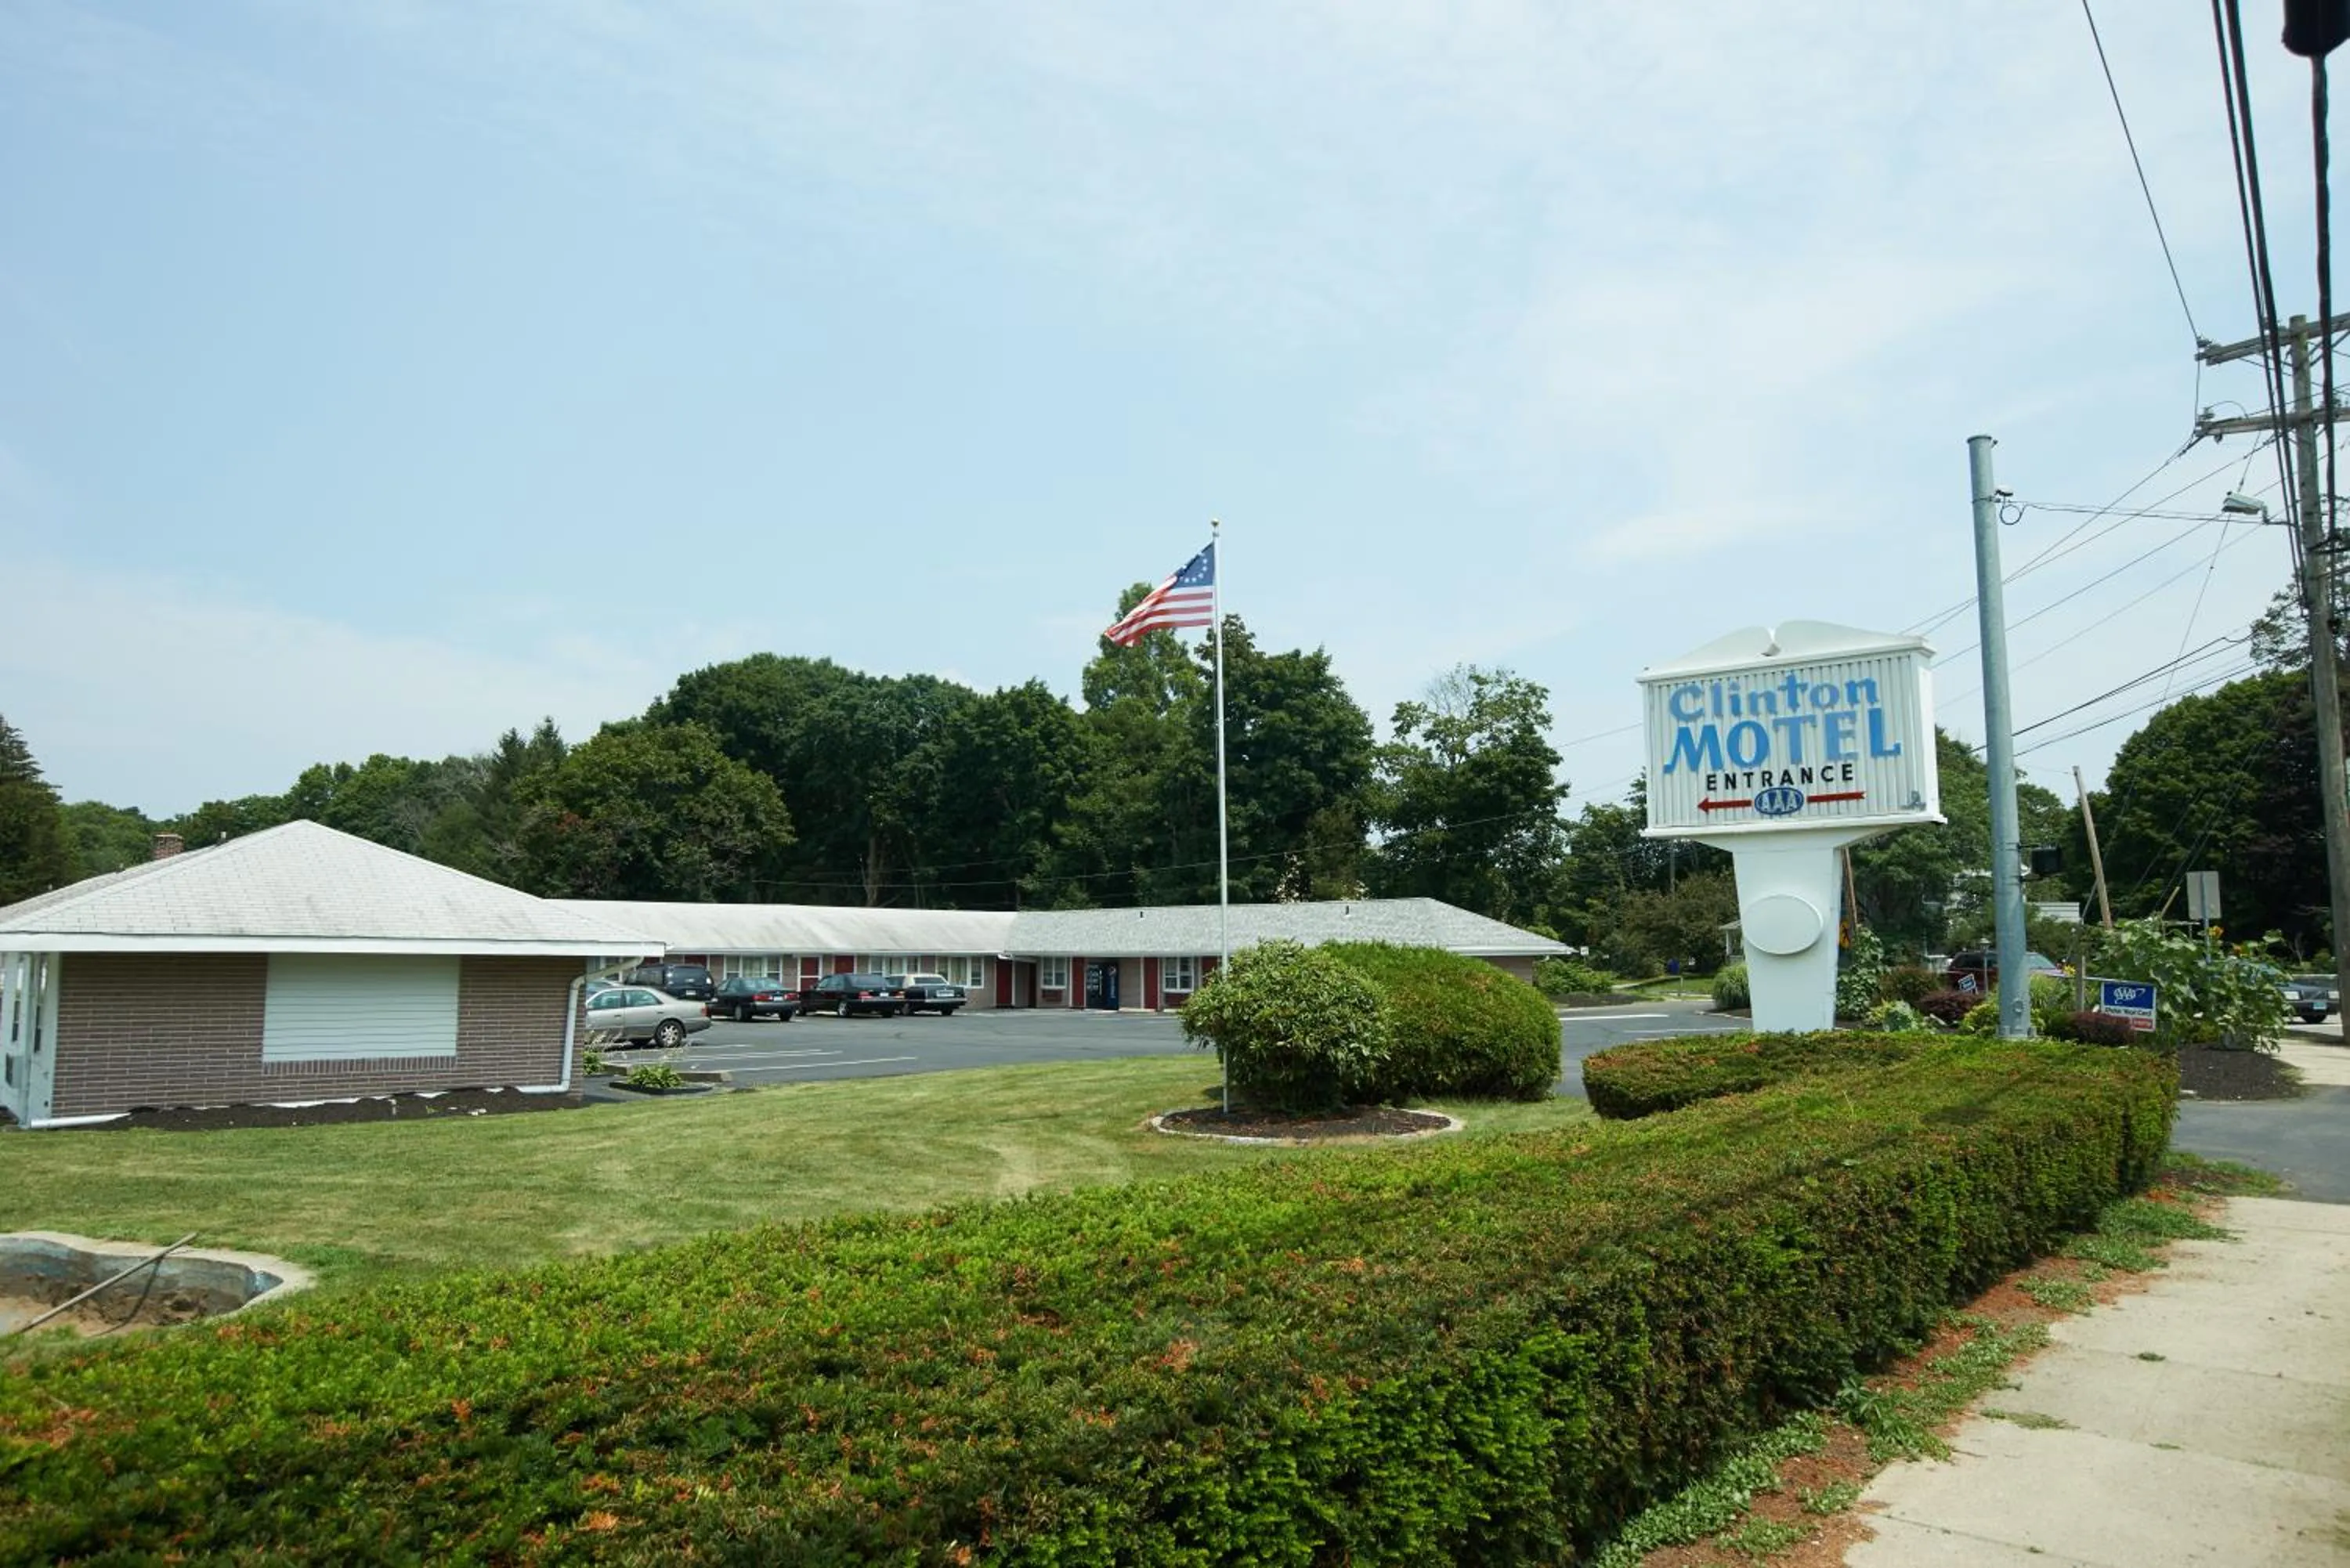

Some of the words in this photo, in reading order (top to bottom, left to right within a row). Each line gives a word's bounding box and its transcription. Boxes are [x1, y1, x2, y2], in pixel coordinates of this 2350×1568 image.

[1670, 670, 1878, 721] Clinton
[1663, 708, 1900, 774] MOTEL
[1706, 763, 1854, 791] ENTRANCE
[1759, 788, 1800, 813] AAA
